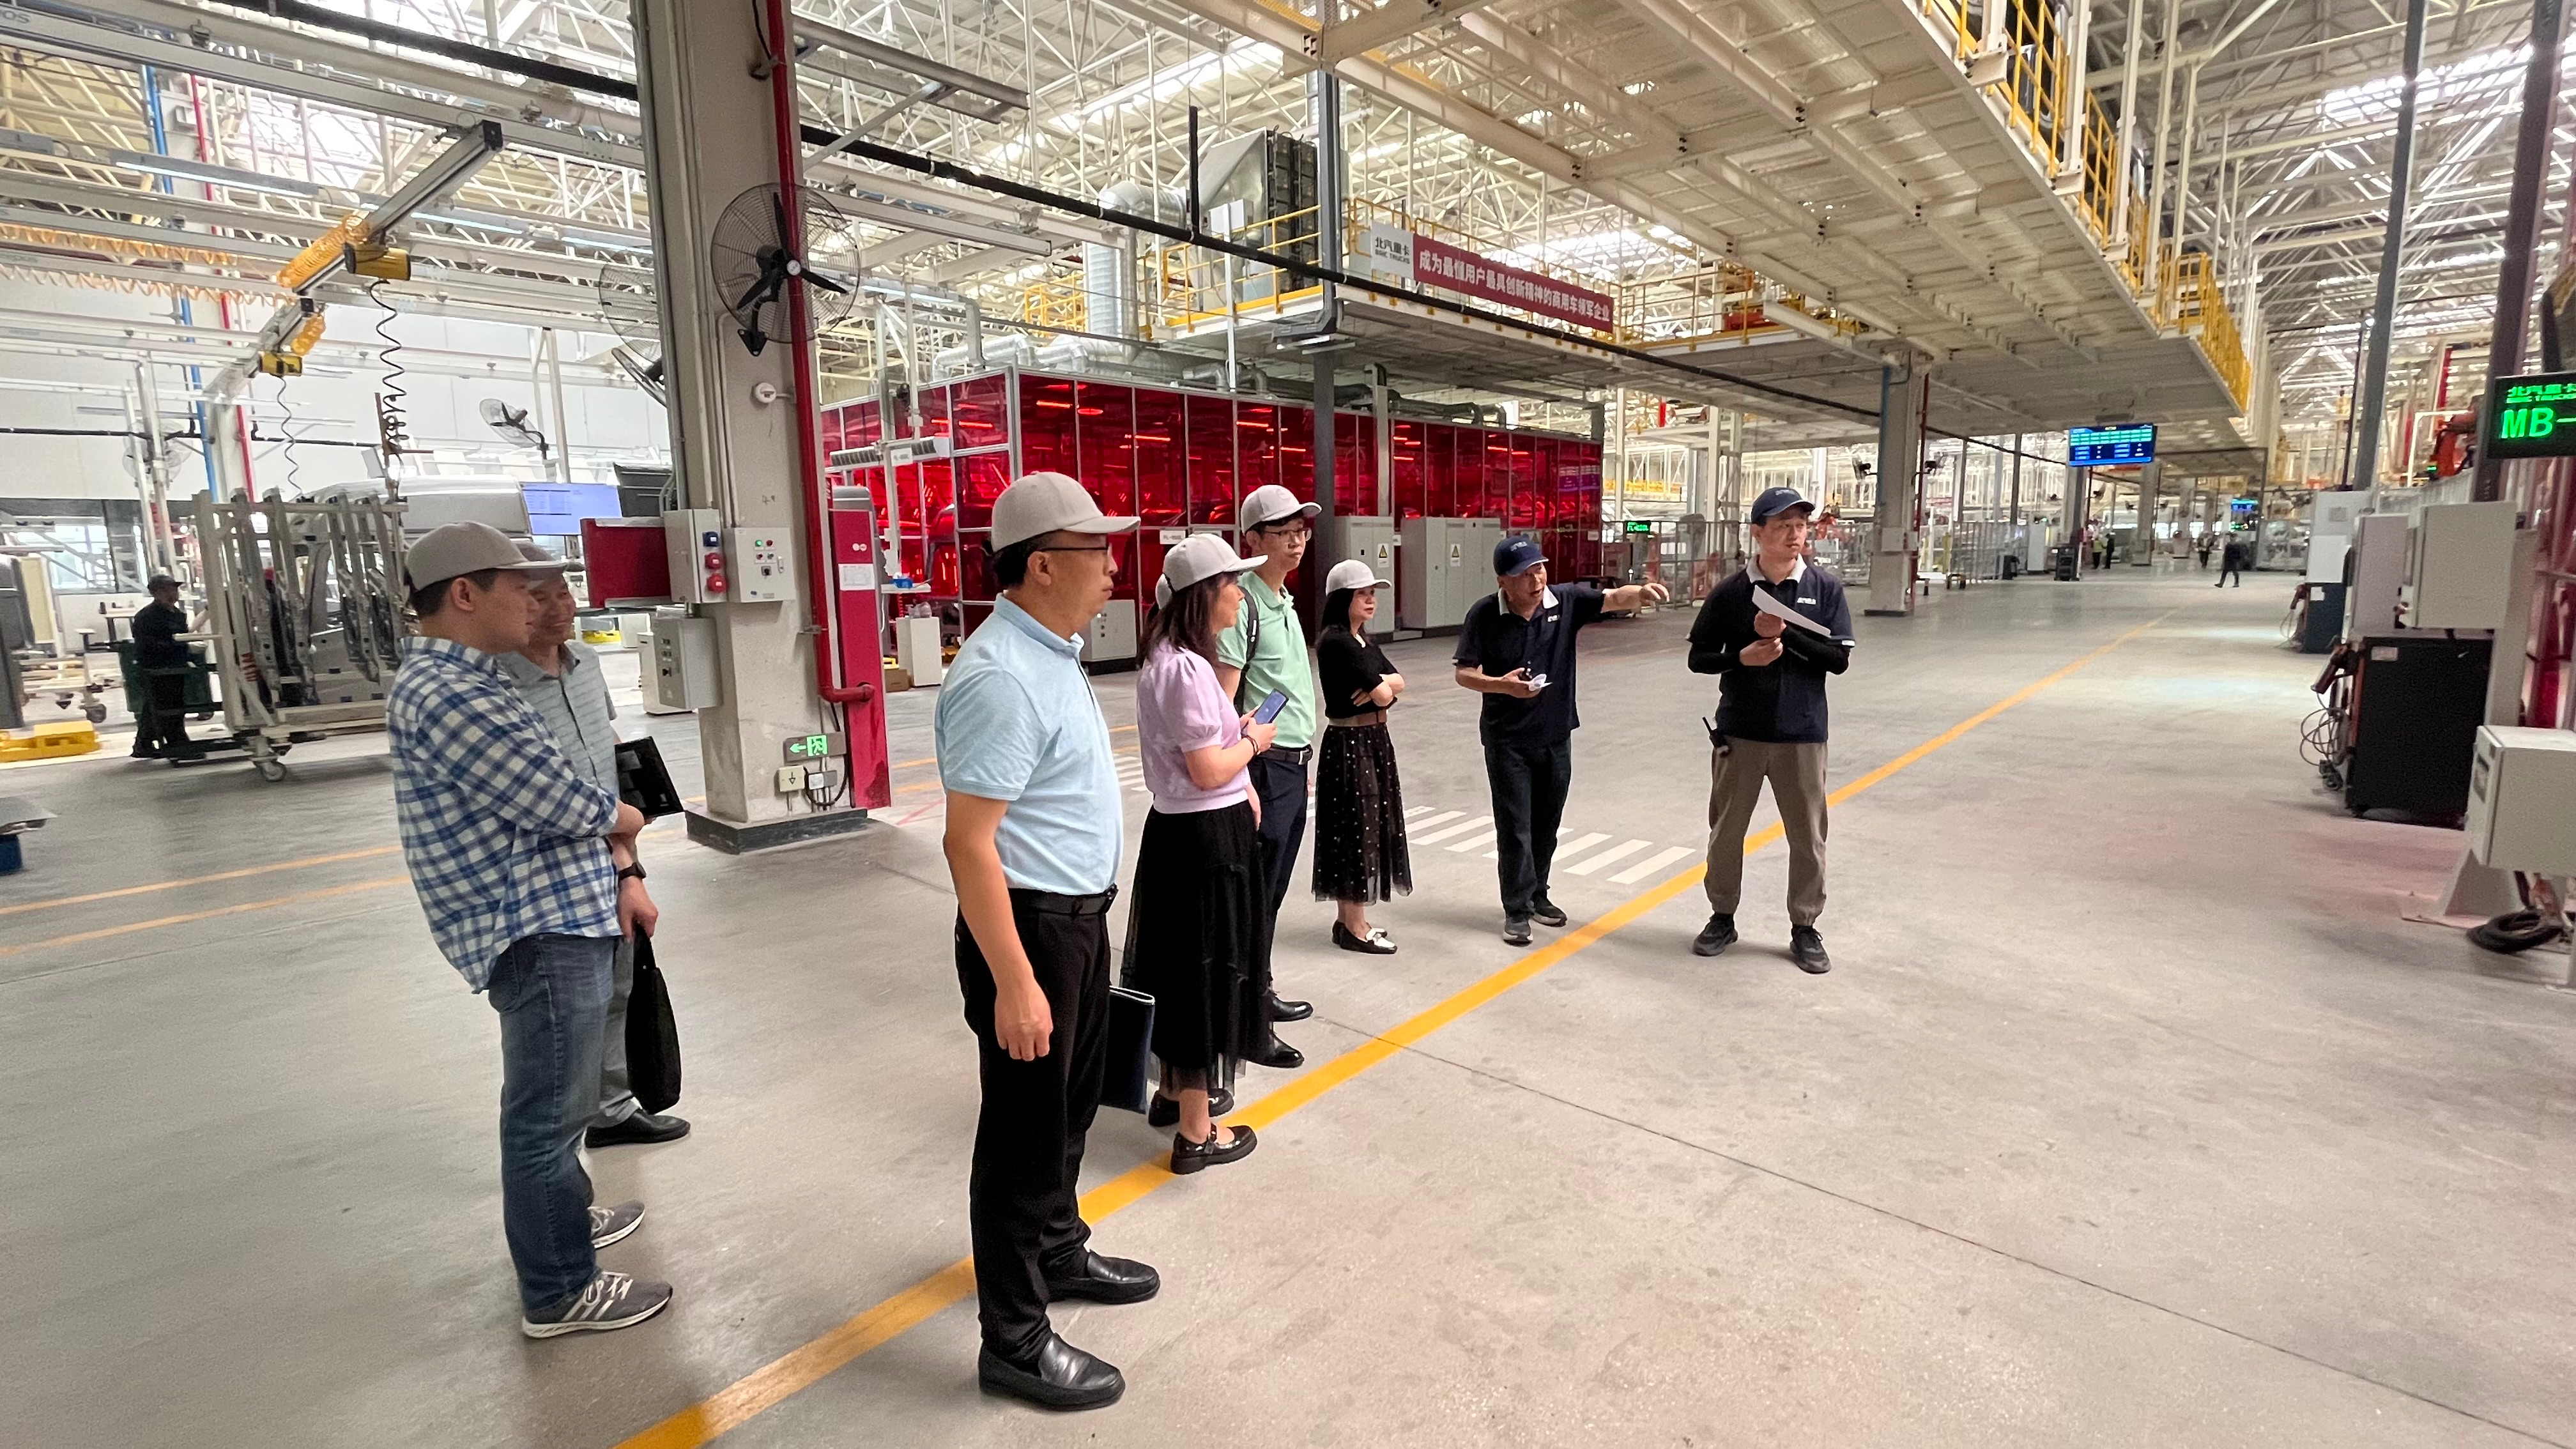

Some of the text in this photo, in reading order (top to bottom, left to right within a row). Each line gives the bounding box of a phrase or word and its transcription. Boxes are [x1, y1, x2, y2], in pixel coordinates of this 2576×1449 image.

[1375, 236, 1410, 256] 北汽重卡
[1419, 249, 1610, 322] 成为最懂用户最具创新精神的商用车领军企业
